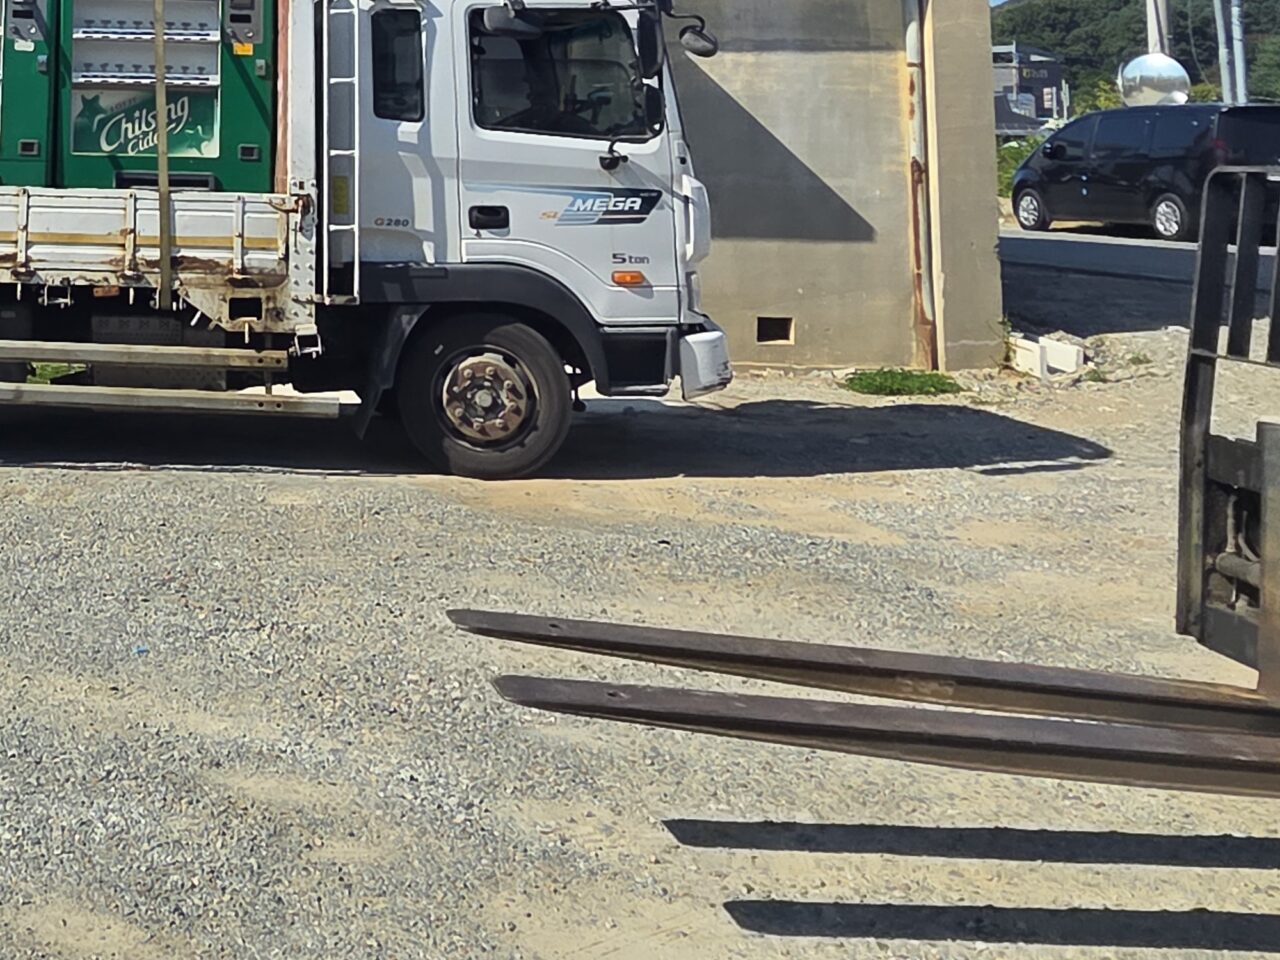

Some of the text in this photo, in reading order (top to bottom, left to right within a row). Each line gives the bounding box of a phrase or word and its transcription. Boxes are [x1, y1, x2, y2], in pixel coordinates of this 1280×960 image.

[100, 96, 188, 152] Chilsng
[571, 197, 642, 212] MEGA
[628, 255, 650, 264] ton
